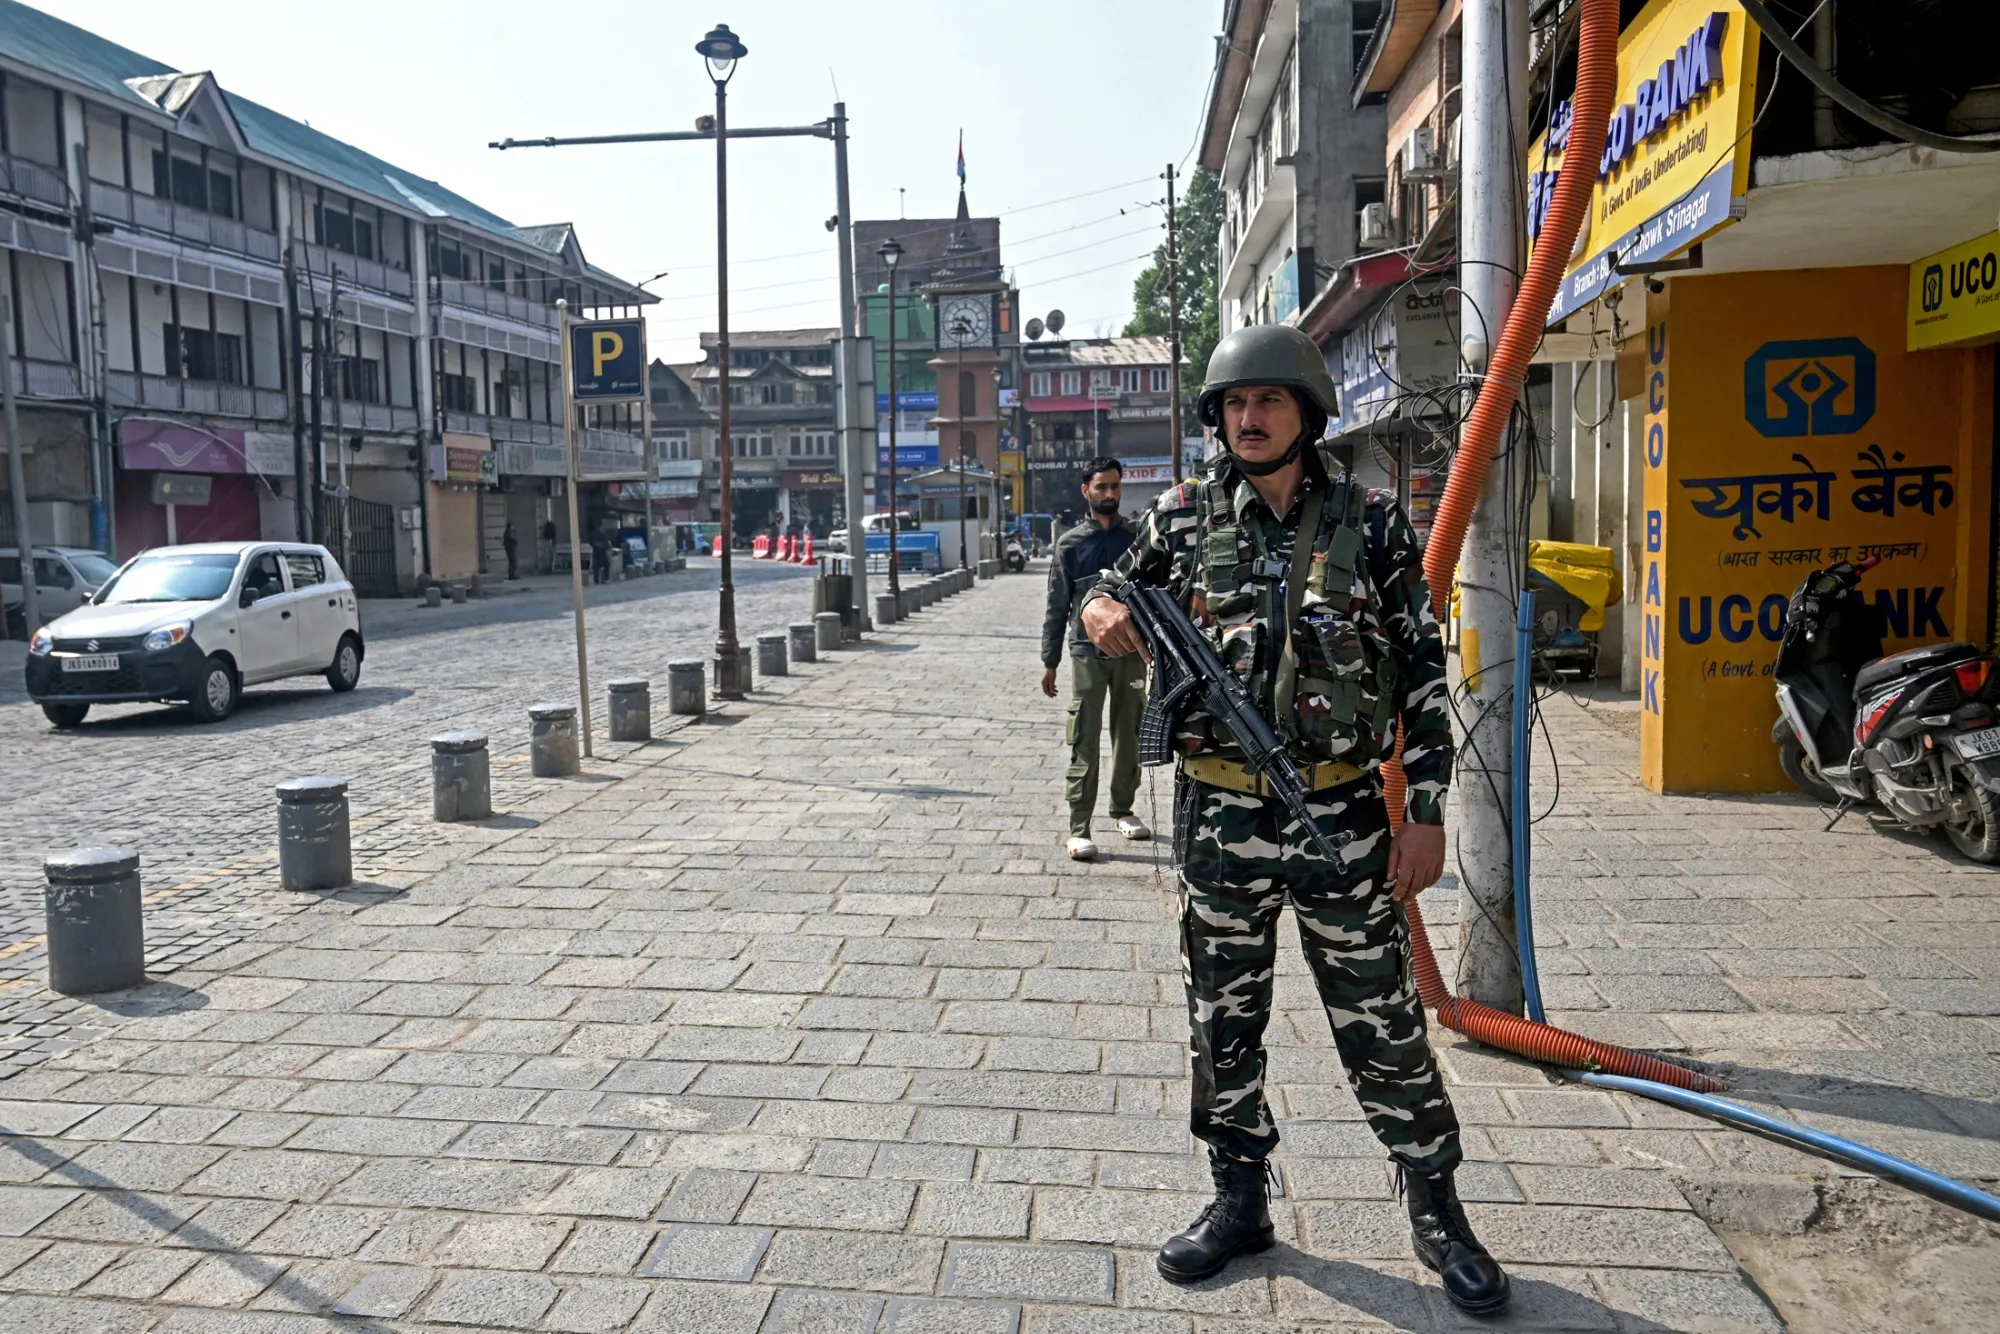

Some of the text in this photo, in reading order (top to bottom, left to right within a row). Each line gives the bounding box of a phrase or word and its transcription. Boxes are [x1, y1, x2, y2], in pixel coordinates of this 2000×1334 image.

[1633, 12, 1729, 146] BANK
[1626, 178, 1634, 204] of
[1635, 167, 1652, 196] India
[1653, 121, 1708, 180] Undertaking)
[1666, 191, 1711, 237] Srinagar
[1950, 252, 1997, 298] UCO
[592, 331, 624, 377] P
[1028, 461, 1068, 470] BOMBAY
[1122, 468, 1157, 479] EXIDE
[1679, 444, 1954, 541] यूको बैंक
[1644, 320, 1666, 716] UCO BANK
[1768, 548, 1823, 566] सरकार
[1828, 546, 1852, 564] का
[1679, 592, 1788, 646] UCO
